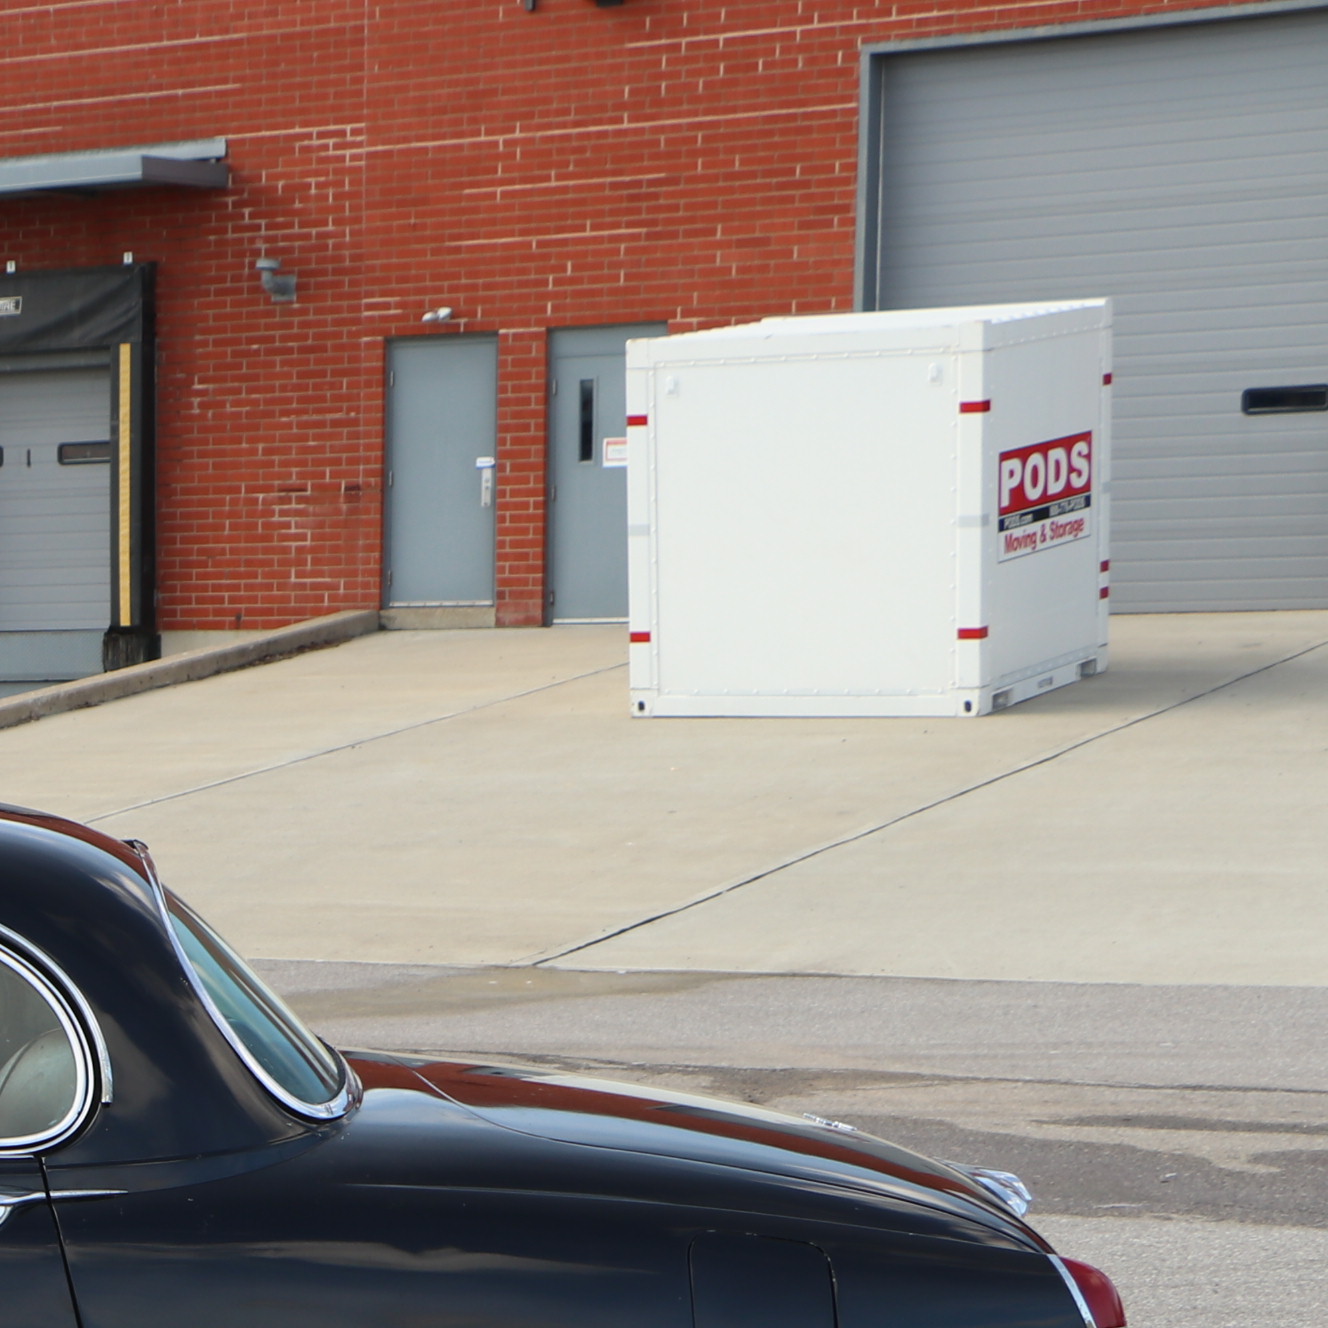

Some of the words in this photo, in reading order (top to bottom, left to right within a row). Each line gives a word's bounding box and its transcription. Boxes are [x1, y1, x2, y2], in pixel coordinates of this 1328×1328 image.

[26, 448, 32, 469] 1
[1000, 440, 1089, 508] PODS
[1004, 529, 1037, 554] Moving
[1039, 522, 1047, 543] &
[1048, 518, 1085, 541] Storage
